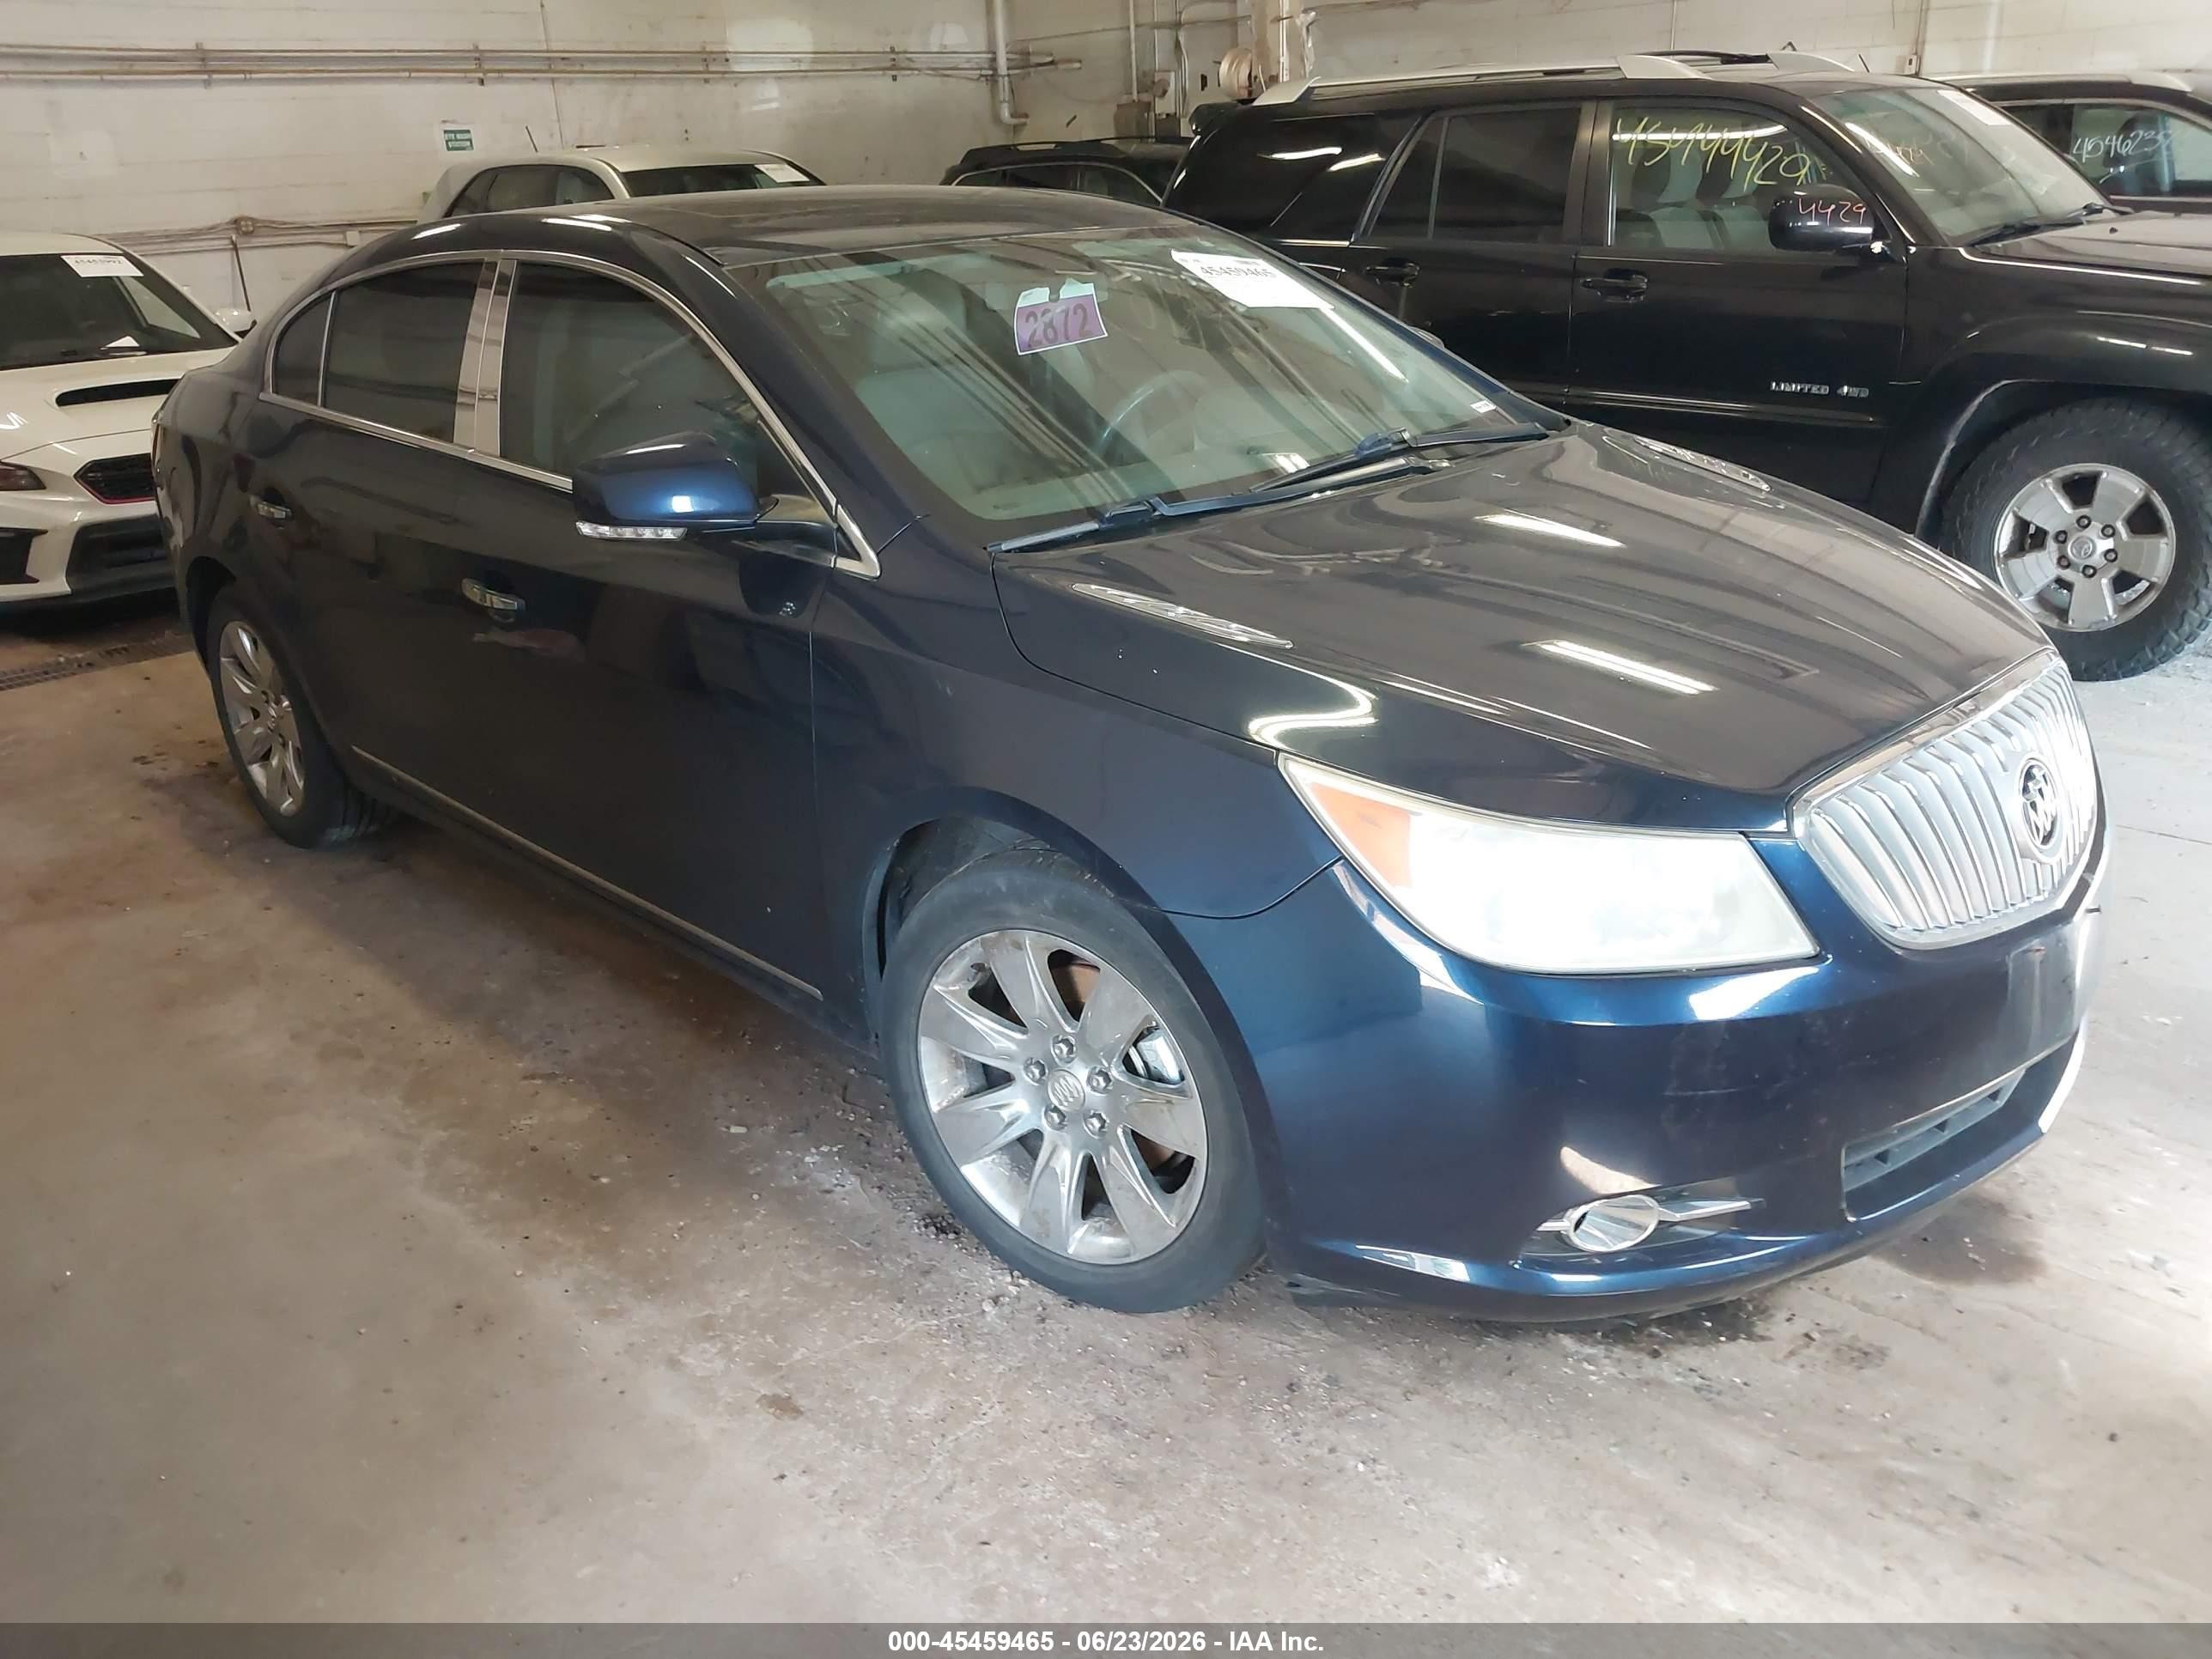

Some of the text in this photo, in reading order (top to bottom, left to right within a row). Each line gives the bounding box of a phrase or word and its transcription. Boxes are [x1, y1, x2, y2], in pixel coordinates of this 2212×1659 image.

[1799, 198, 1867, 226] 4429
[1024, 302, 1093, 349] 2872
[1770, 381, 1829, 395] LIMITED
